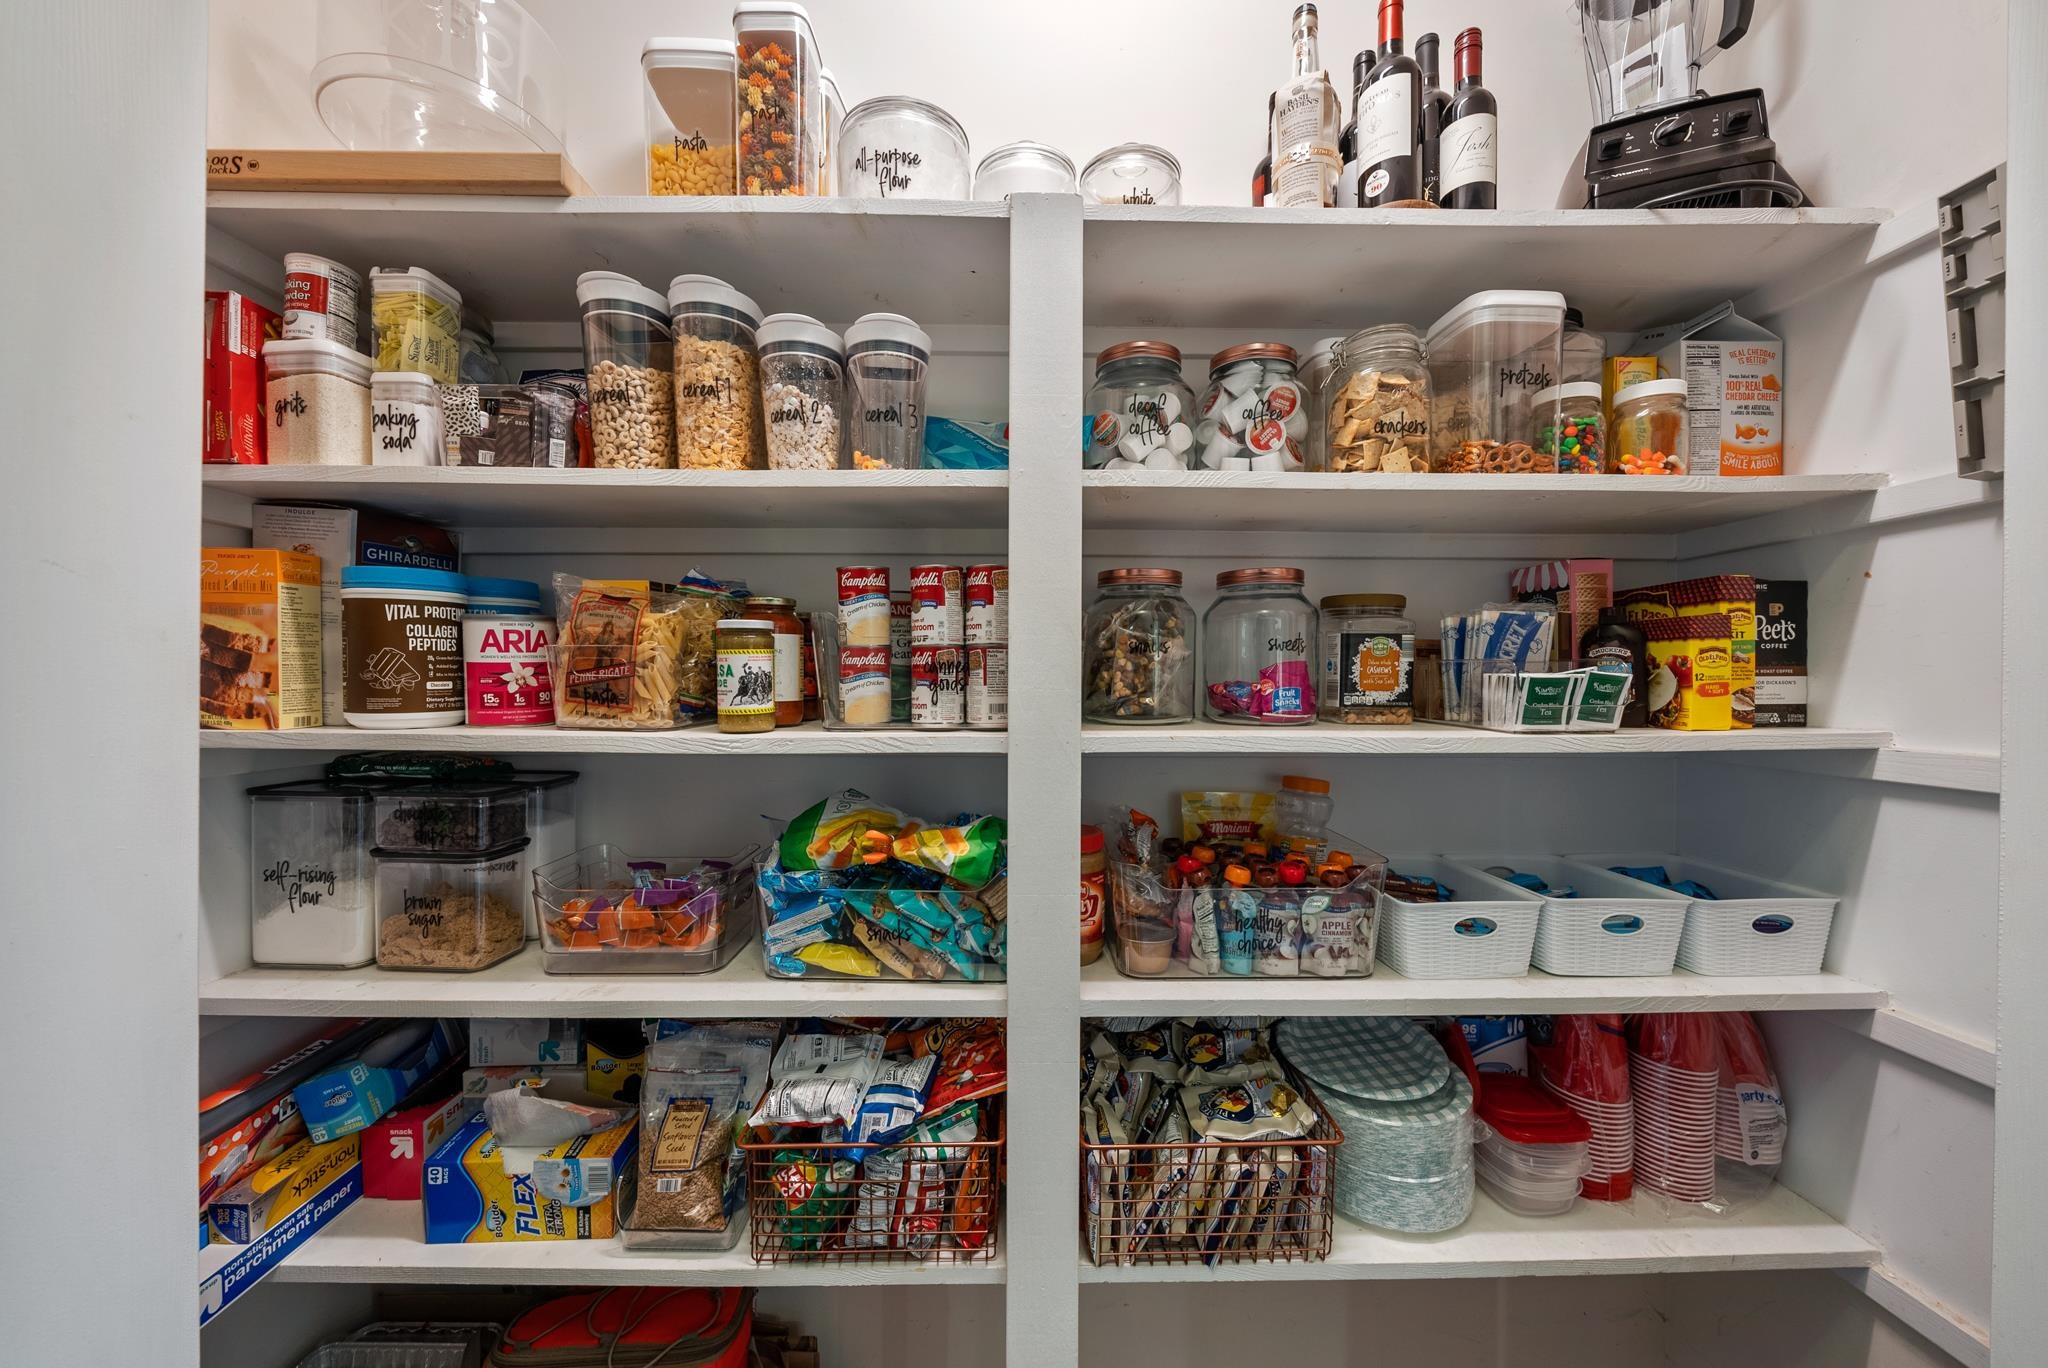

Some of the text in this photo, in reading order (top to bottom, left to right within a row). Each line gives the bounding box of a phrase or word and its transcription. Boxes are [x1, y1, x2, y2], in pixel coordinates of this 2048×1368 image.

[1279, 98, 1320, 117] HAYDEN'S
[1287, 93, 1311, 107] BASIL
[751, 99, 787, 131] pasta
[674, 130, 708, 161] pasta
[855, 146, 922, 174] all-purpose
[879, 166, 912, 198] flour
[1611, 167, 1650, 178] Vitamix
[1370, 183, 1384, 194] 90
[286, 279, 311, 291] king
[1728, 348, 1776, 360] REAL CHEDDAR
[683, 377, 721, 404] cereal
[1500, 363, 1552, 397] pretzels
[1746, 381, 1762, 391] REAL
[1129, 392, 1167, 417] decaf
[1725, 392, 1780, 402] CHEDDAR CHEESE
[275, 391, 307, 427] grits
[771, 400, 823, 426] cereal 2
[865, 404, 919, 428] cereal 3
[1242, 398, 1285, 430] coffee
[372, 404, 420, 440] baking
[1129, 413, 1171, 446] coffee
[1374, 411, 1428, 436] crackers
[241, 414, 255, 459] Millville
[382, 427, 412, 452] soda
[1722, 456, 1780, 470] SMILE ABOUT!
[366, 547, 453, 570] GHIRARDELLI
[201, 560, 275, 588] Pumpkin
[841, 571, 886, 590] Campbell's
[260, 581, 272, 591] Mix
[384, 604, 420, 621] VITAL
[846, 605, 864, 617] Cream
[868, 601, 887, 609] Chicken
[406, 623, 458, 639] COLLAGEN
[1755, 615, 1796, 641] Peet's
[408, 638, 457, 652] PEPTIDES
[480, 629, 549, 653] ARIA
[1267, 632, 1306, 656] sweets
[718, 663, 734, 678] SA
[841, 650, 886, 669] Campbell's
[1366, 665, 1392, 674] CASHEWS
[599, 666, 630, 679] RIGATE
[1695, 673, 1705, 681] 12
[539, 692, 551, 701] 90
[845, 684, 861, 695] Cream
[929, 678, 965, 706] goods
[1278, 689, 1296, 698] Fruit
[1275, 699, 1301, 707] Snacks
[1540, 708, 1552, 716] Tea
[1209, 821, 1252, 834] Mariani
[263, 861, 337, 896] self-rising
[288, 882, 322, 913] flour
[403, 889, 442, 915] brown
[407, 911, 444, 938] sugar
[1235, 907, 1286, 944] healthy
[1321, 921, 1352, 931] APPLE
[1237, 931, 1277, 954] choice
[1462, 1024, 1477, 1034] 96
[323, 1090, 353, 1107] Boulder
[662, 1131, 695, 1141] Sunflower
[665, 1142, 686, 1152] Seeds
[430, 1168, 440, 1184] 40
[514, 1173, 541, 1235] FLEX
[491, 1199, 503, 1238] Boulder
[544, 1203, 557, 1234] EXTRA
[552, 1199, 565, 1236] STRONG
[223, 1181, 353, 1293] parchment paper
[223, 1202, 315, 1276] non-stick, oven safe
